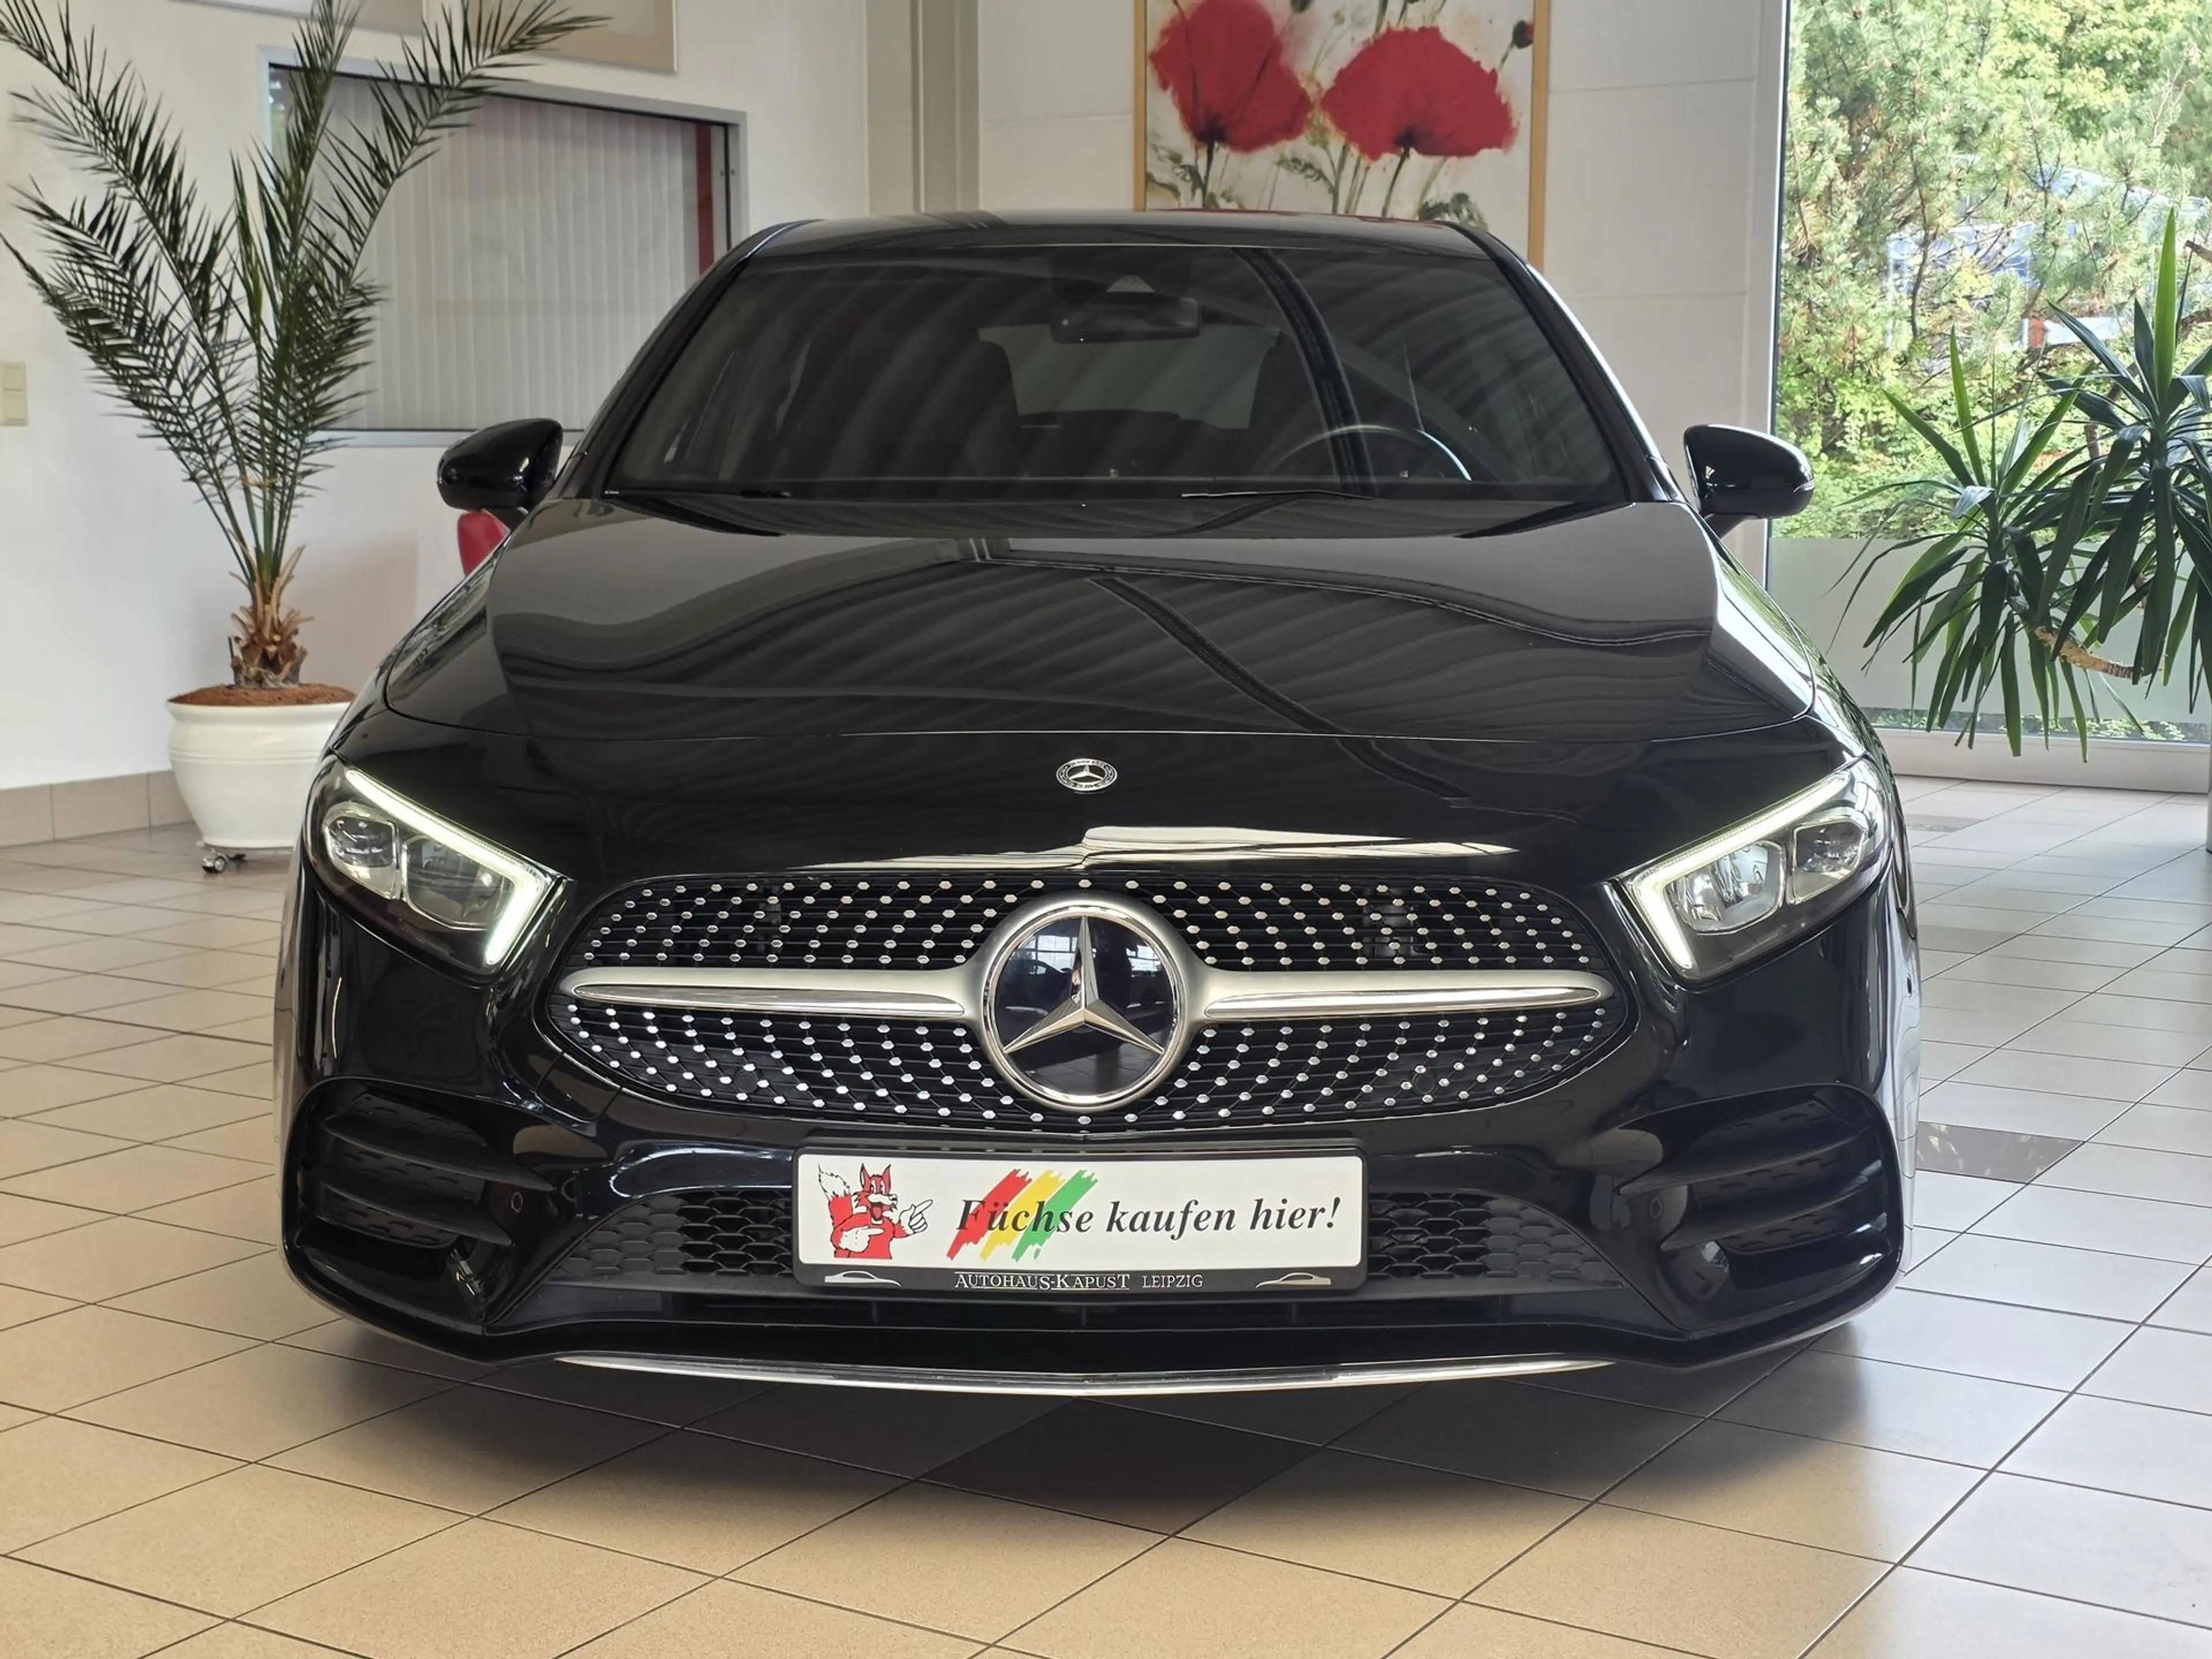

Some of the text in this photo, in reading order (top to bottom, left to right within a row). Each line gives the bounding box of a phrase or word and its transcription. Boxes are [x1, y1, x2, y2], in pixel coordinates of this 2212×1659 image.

[956, 1197, 1340, 1240] Füchse kaufen hier!
[1142, 1274, 1204, 1288] LEIPZIG
